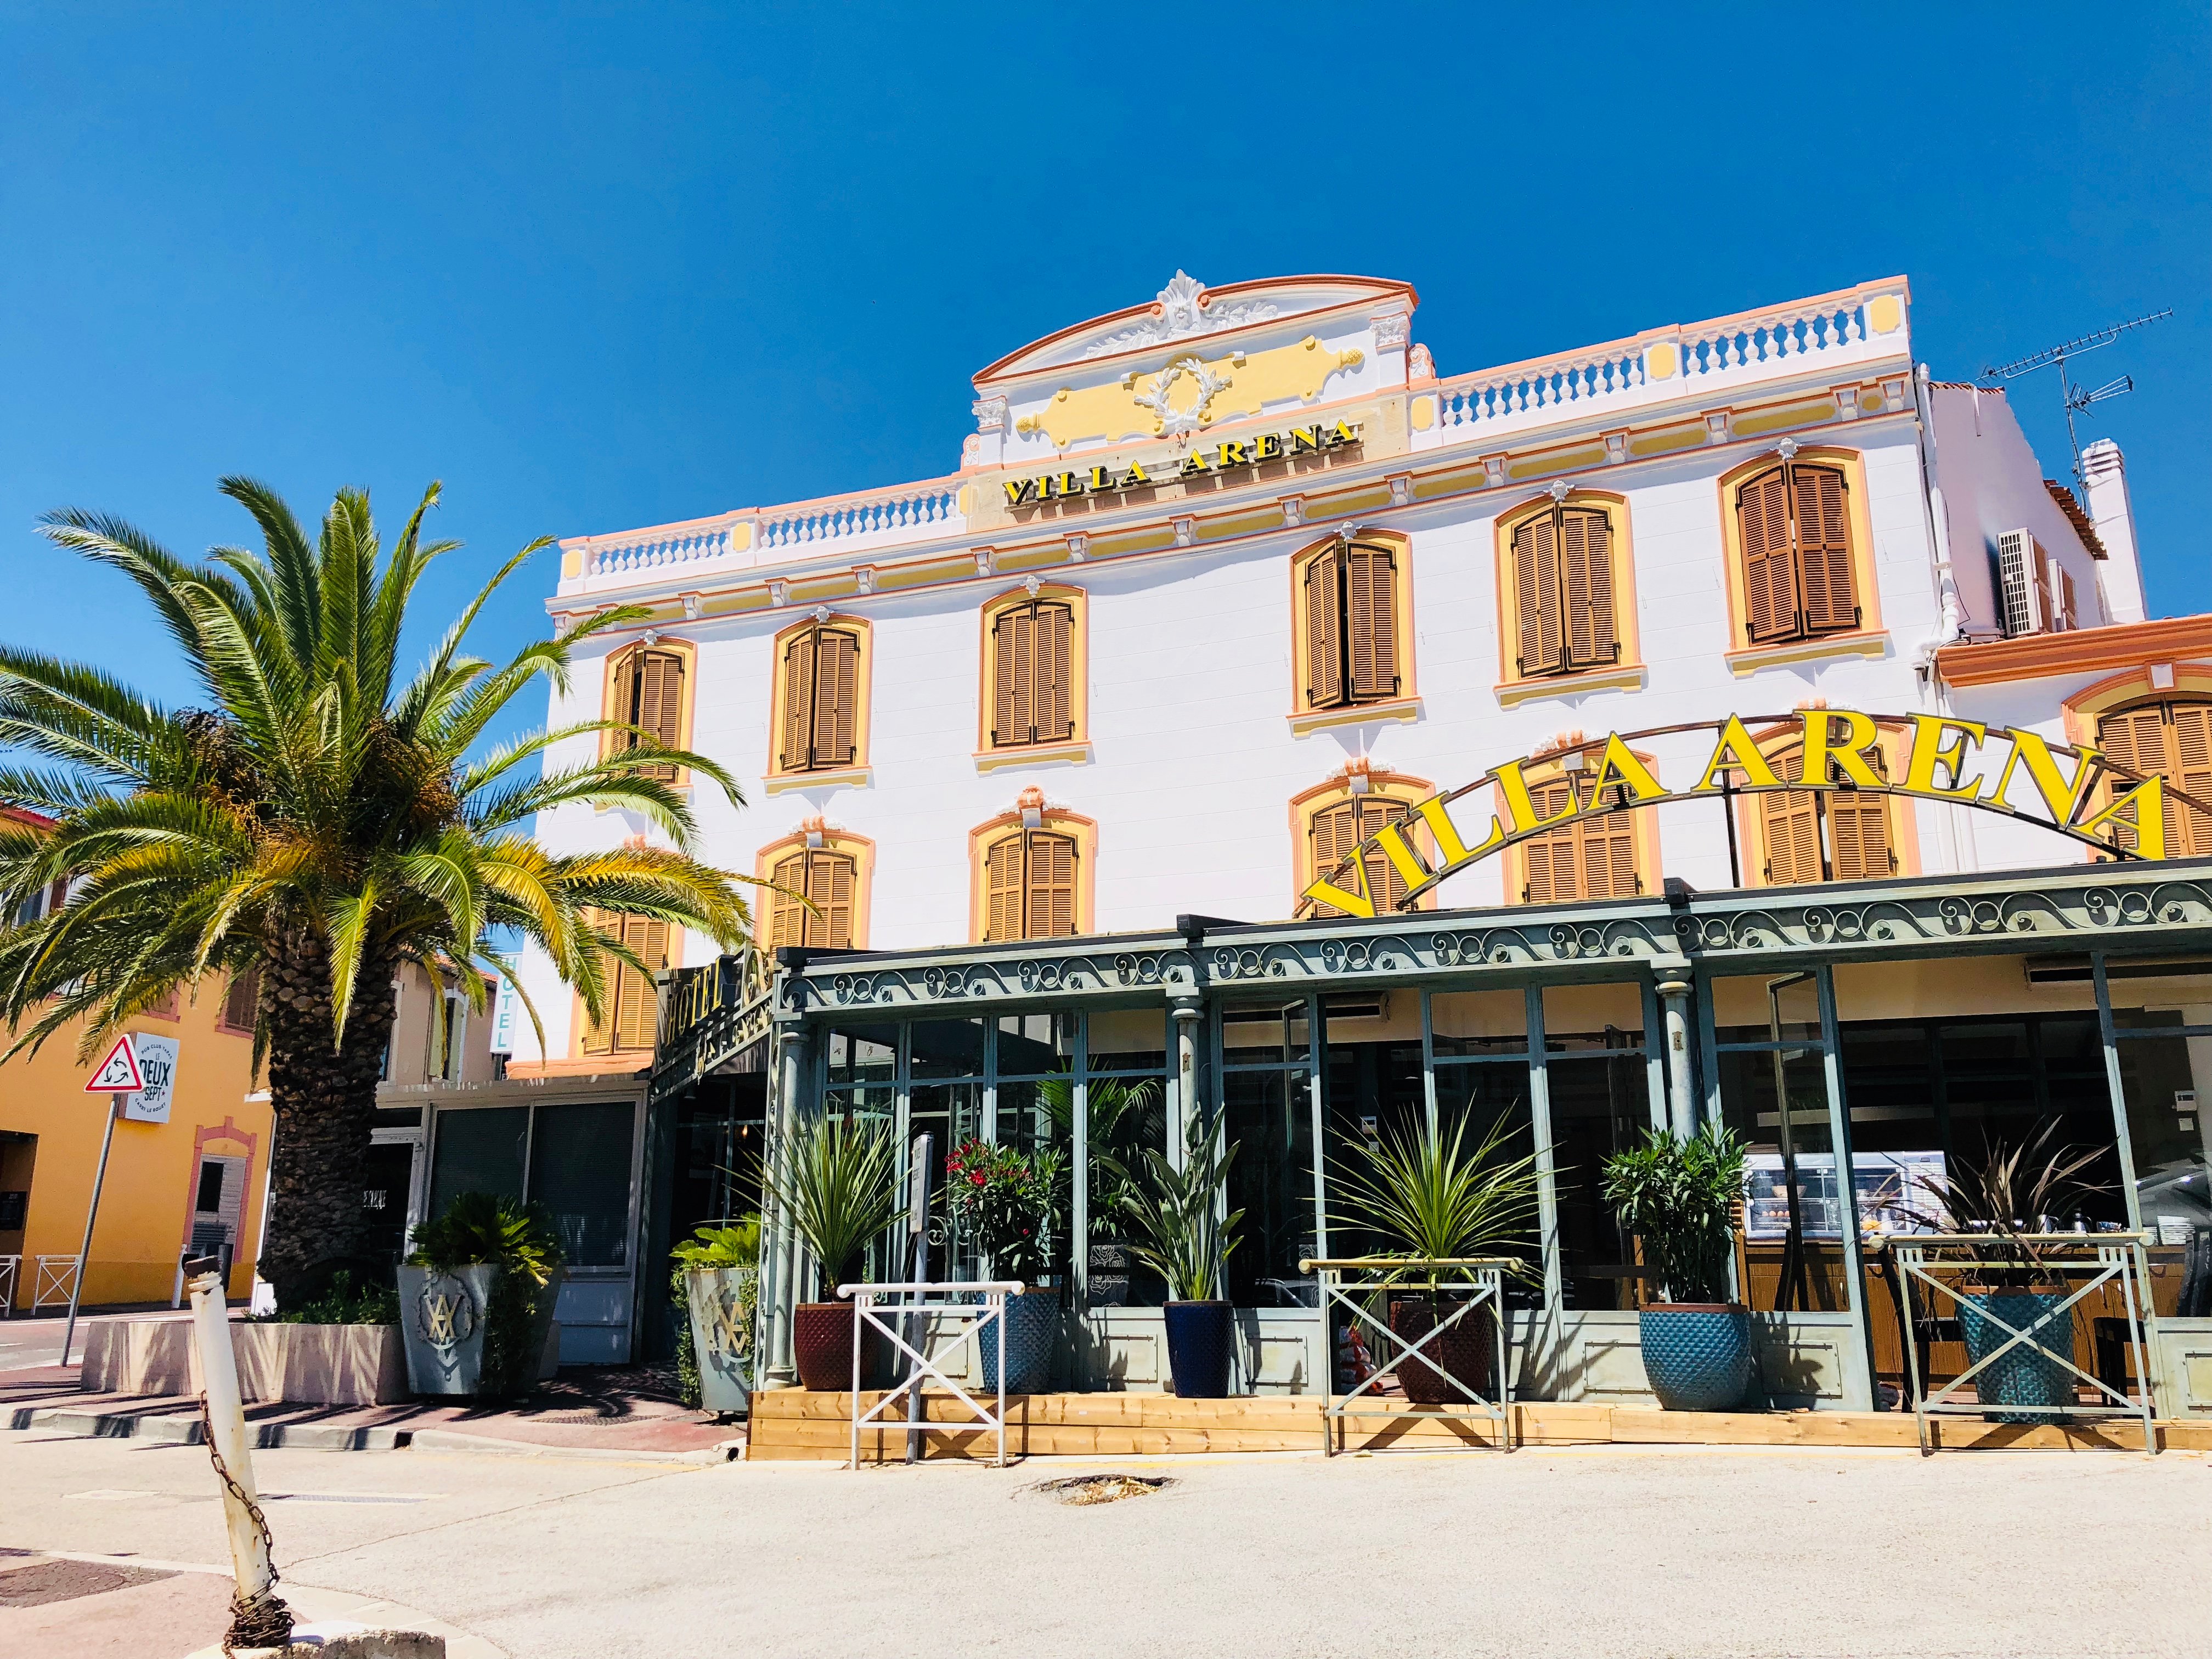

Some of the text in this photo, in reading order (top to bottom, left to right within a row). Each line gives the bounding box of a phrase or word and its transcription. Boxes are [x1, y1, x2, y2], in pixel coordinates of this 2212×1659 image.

[1002, 419, 1359, 505] VILLA ARENA
[1299, 709, 2166, 918] VILLA ARENA
[497, 957, 517, 1048] HOTEL
[667, 955, 725, 1046] HOTEL
[139, 1059, 171, 1087] DEUX
[141, 1046, 150, 1055] PUB
[162, 1046, 172, 1059] TAPAS
[155, 1052, 160, 1060] LE
[144, 1086, 162, 1102] SEPT
